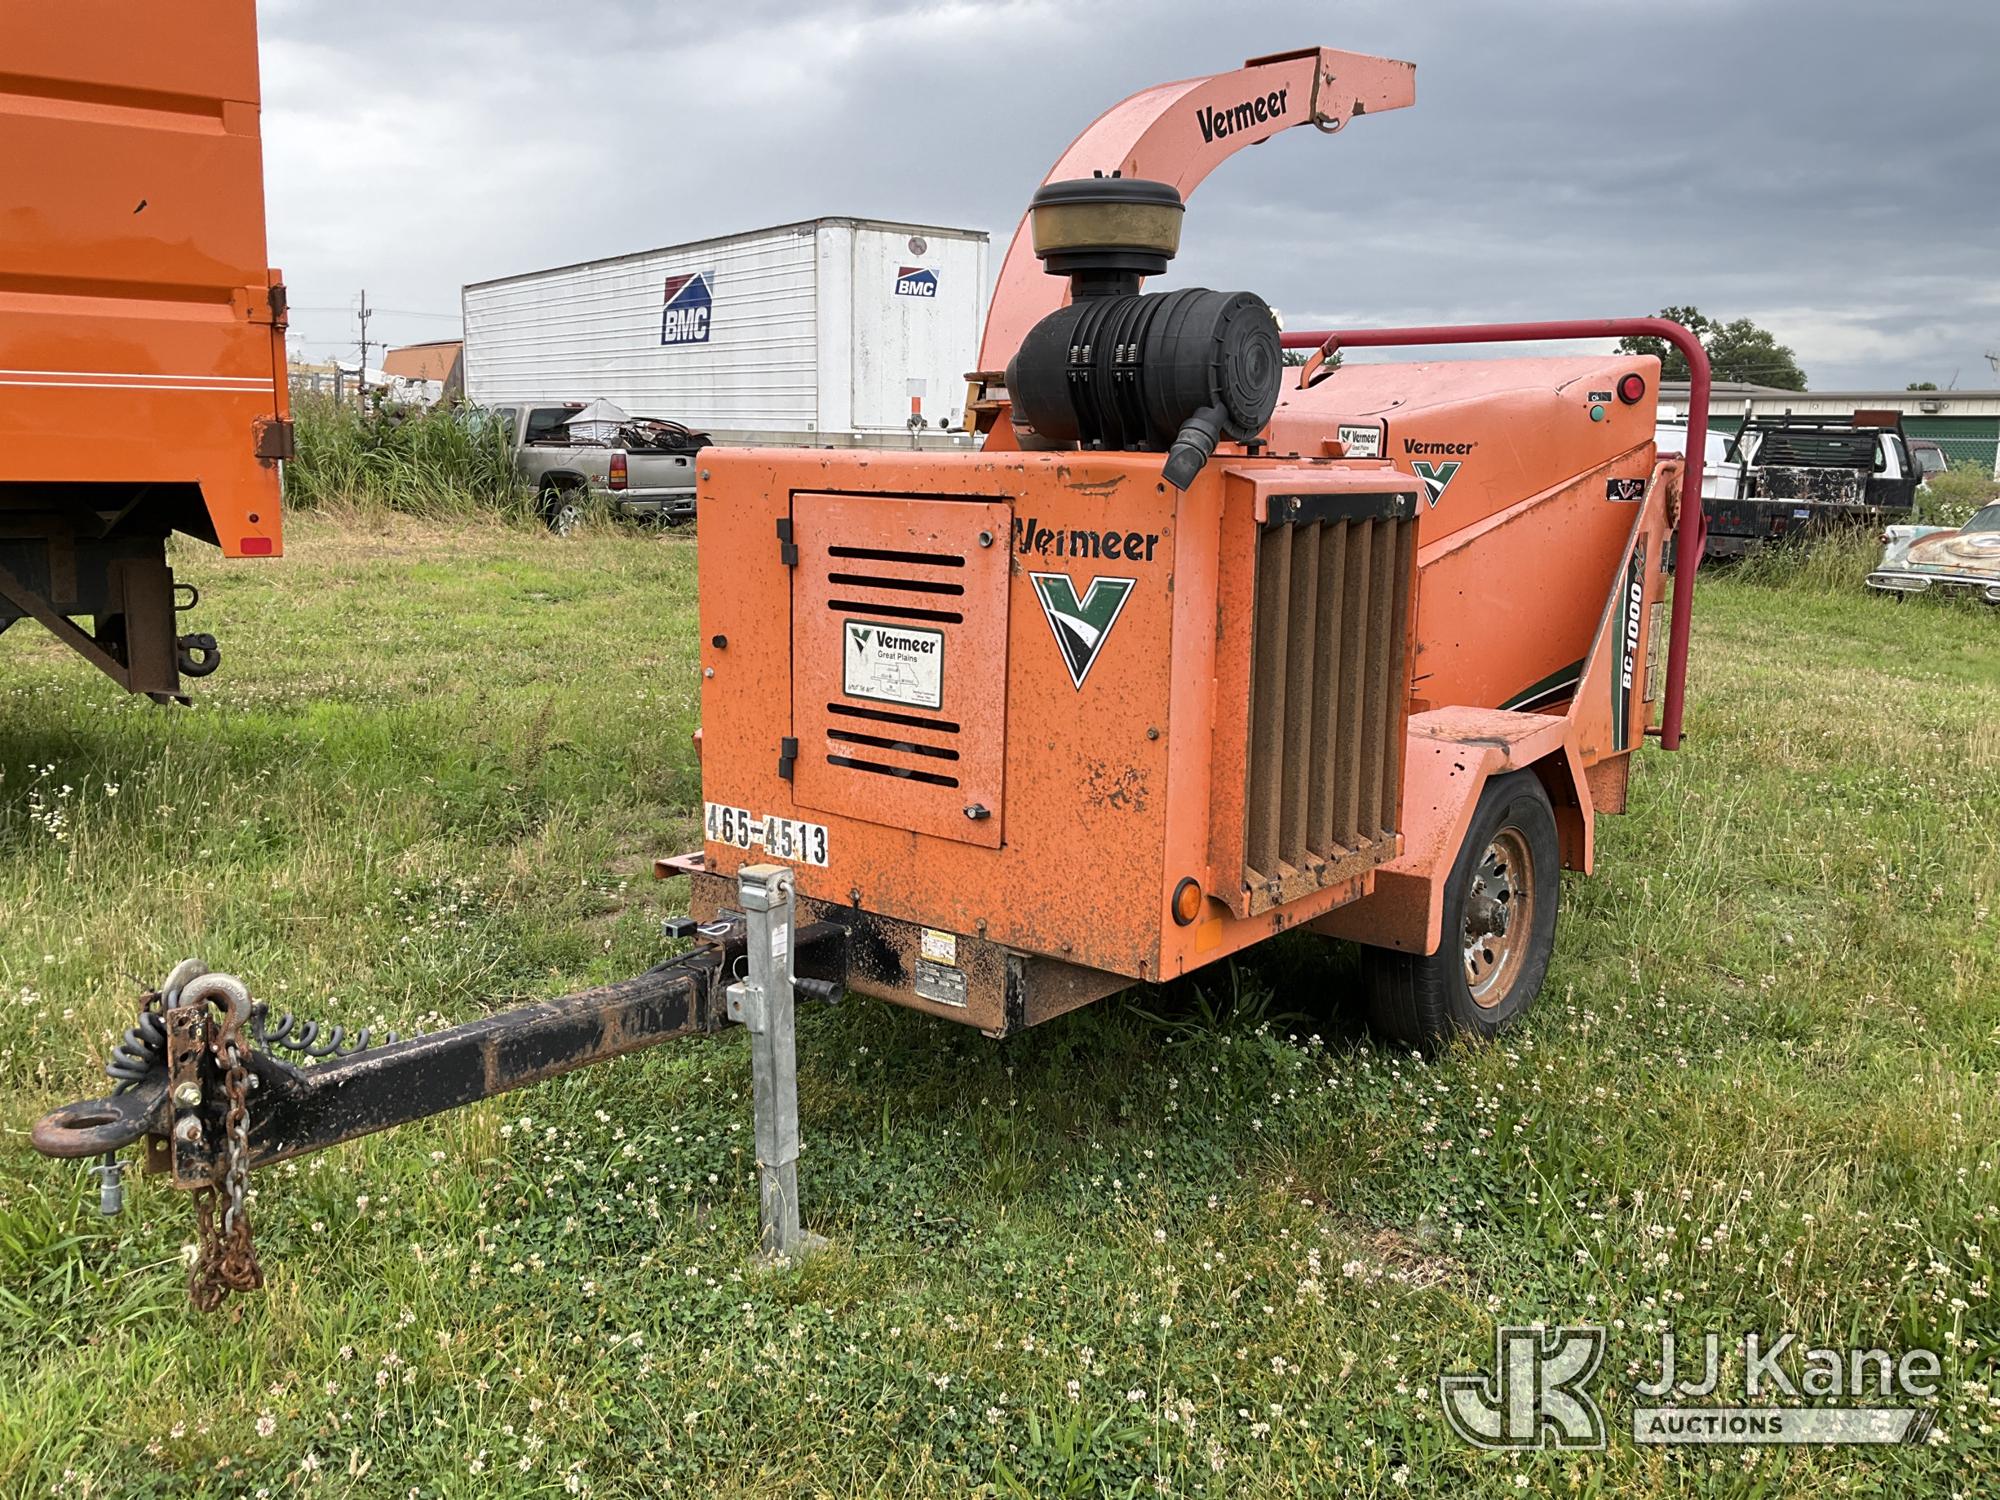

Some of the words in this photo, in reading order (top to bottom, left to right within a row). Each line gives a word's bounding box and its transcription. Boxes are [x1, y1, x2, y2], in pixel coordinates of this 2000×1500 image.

[1196, 88, 1287, 143] Vermeer
[898, 280, 934, 296] BMC
[664, 306, 708, 342] BMC
[1352, 430, 1377, 444] Vermeer
[1404, 438, 1473, 455] Vermeer
[876, 630, 936, 654] Vermeer
[877, 650, 896, 660] Great
[897, 653, 918, 663] Plains
[707, 804, 826, 864] 465-4513
